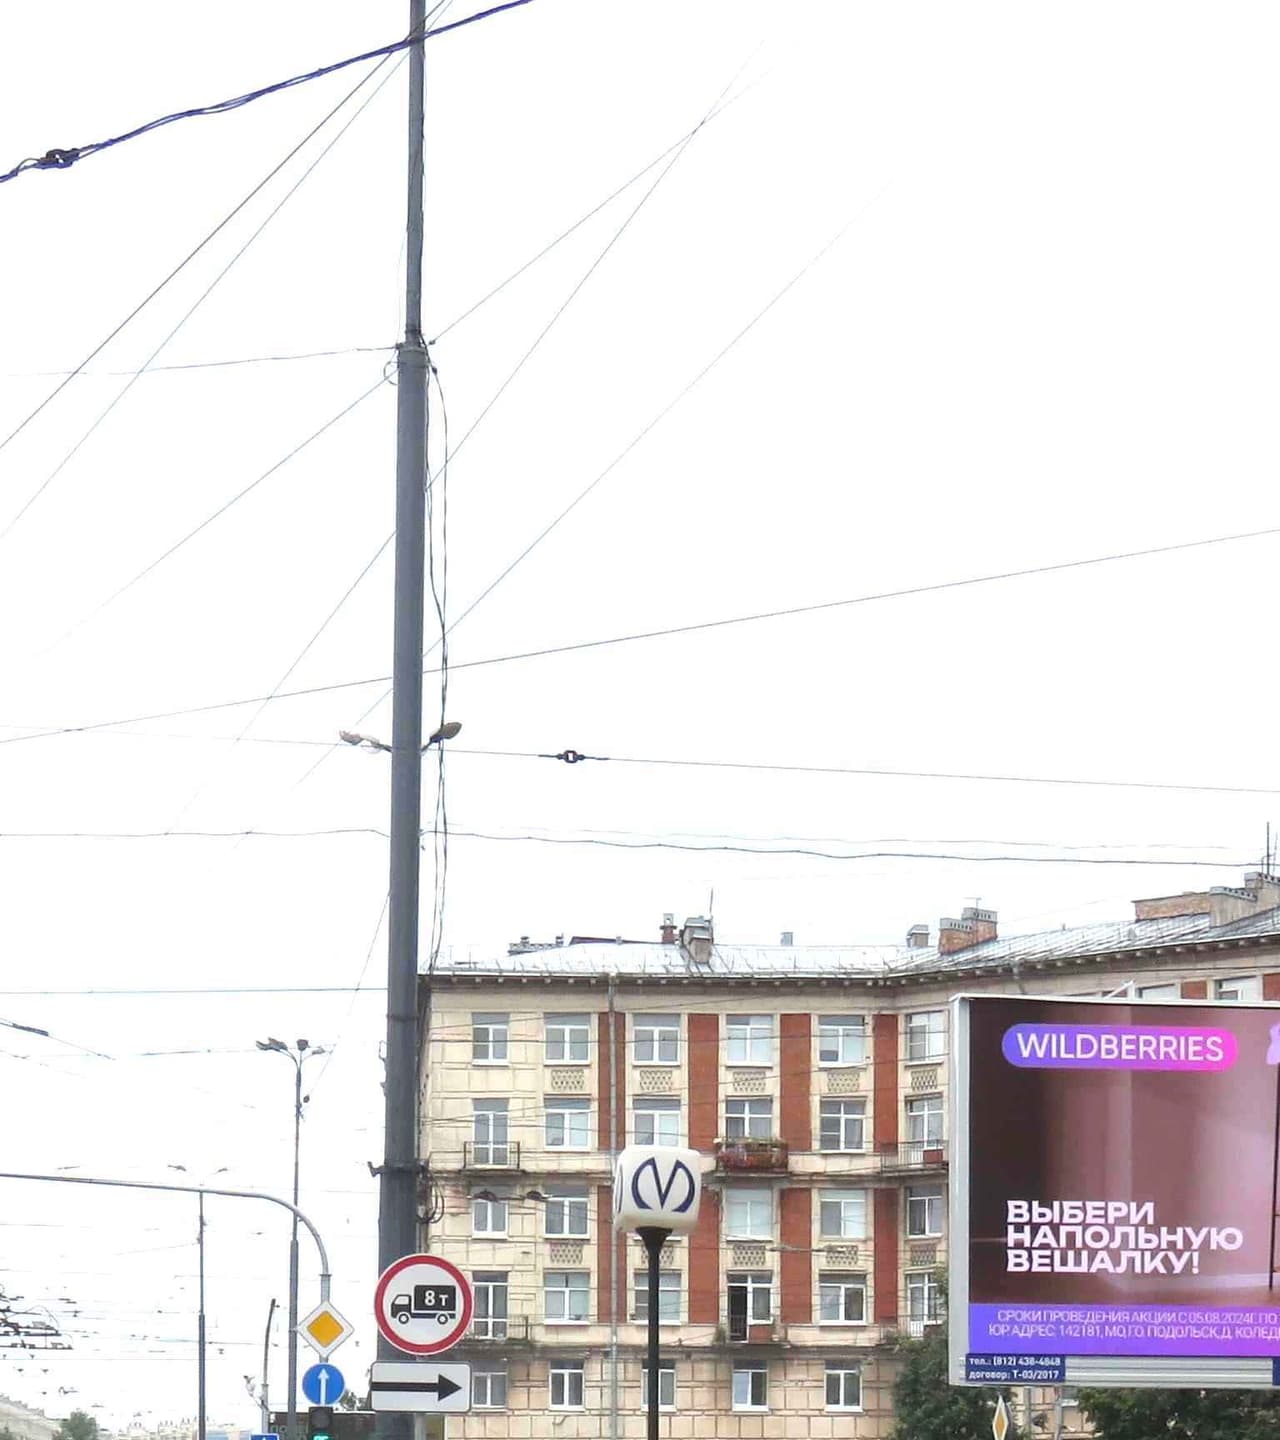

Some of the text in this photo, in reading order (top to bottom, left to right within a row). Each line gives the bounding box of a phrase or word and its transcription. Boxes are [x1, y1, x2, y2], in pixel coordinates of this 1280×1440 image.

[1015, 1032, 1225, 1062] WILDBERRIES
[1006, 1199, 1155, 1225] ВЫБЕРИ
[1006, 1225, 1244, 1251] НАПОЛЬНУЮ
[1006, 1249, 1200, 1275] ВЕШАЛКУ!
[997, 1310, 1043, 1322] СРОКИ
[1043, 1310, 1131, 1324] ПРОВЕДЕНИЯ
[1131, 1311, 1177, 1325] АКЦИИ
[1258, 1313, 1278, 1325] ПО
[992, 1355, 1017, 1366] (812)
[968, 1370, 1011, 1380] договор:
